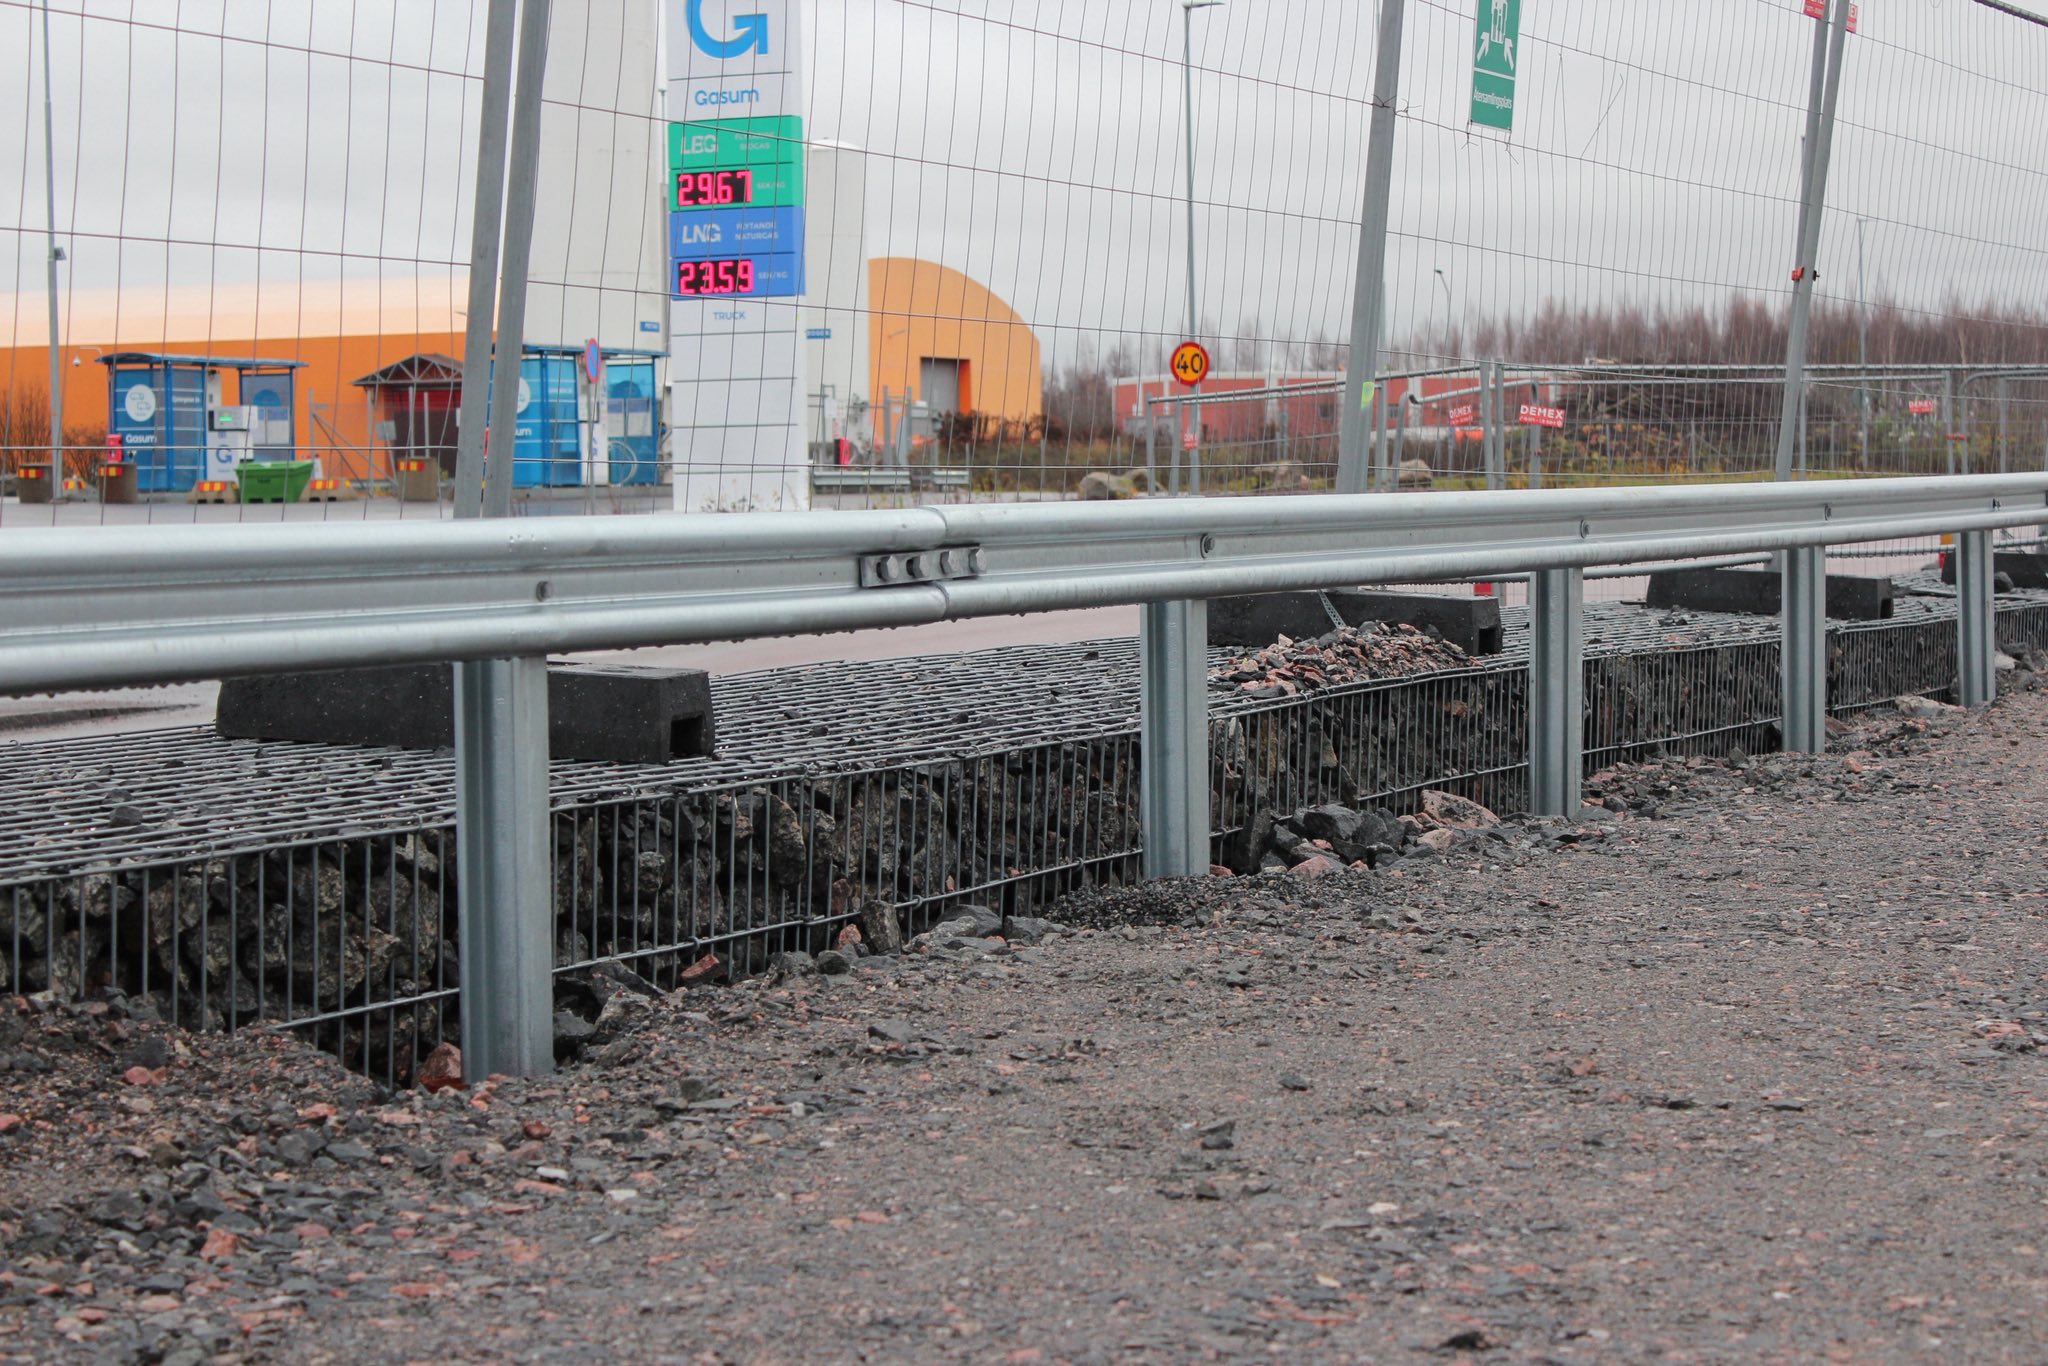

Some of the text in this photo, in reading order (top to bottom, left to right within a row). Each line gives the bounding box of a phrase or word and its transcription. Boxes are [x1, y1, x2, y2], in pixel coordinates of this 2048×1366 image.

[694, 88, 760, 106] Gasum
[680, 134, 719, 154] LBG
[678, 170, 752, 206] 29.67
[682, 223, 721, 244] LNG
[680, 260, 754, 294] 23.59
[713, 311, 746, 321] TRUCK
[1177, 353, 1204, 375] 40
[1520, 404, 1564, 420] DEMEX
[125, 433, 158, 443] Gasum
